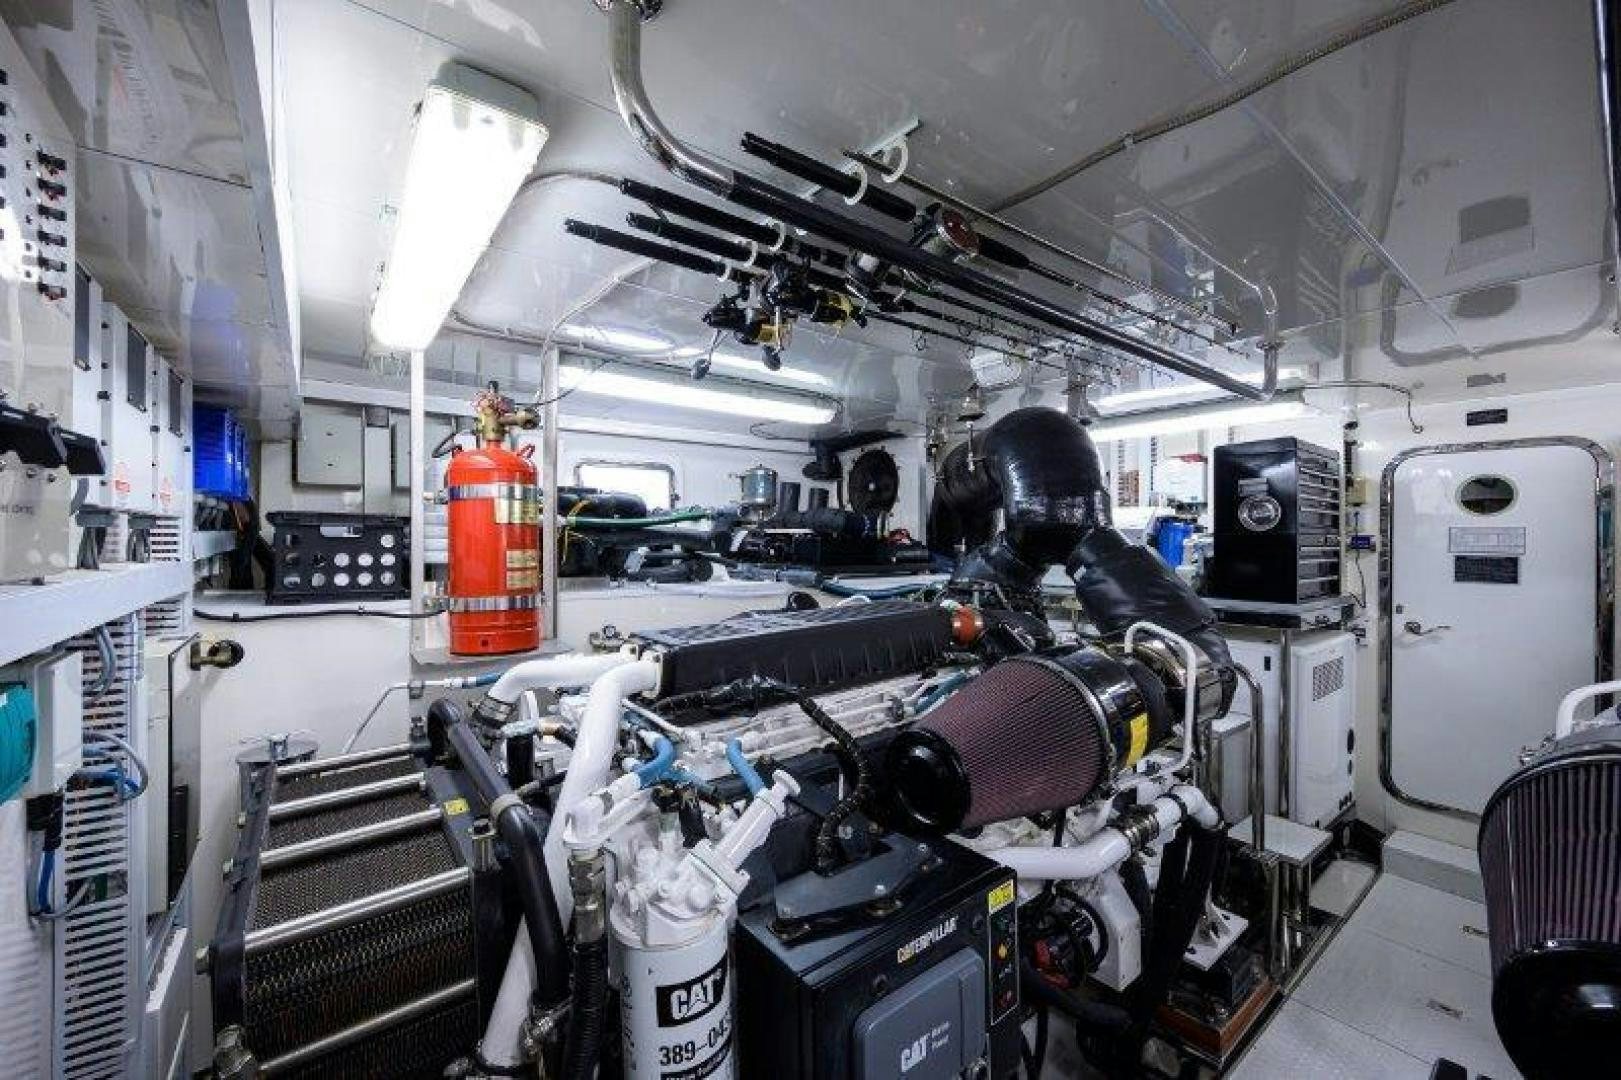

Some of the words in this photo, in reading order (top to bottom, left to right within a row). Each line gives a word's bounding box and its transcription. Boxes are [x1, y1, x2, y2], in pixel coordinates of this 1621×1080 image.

[897, 916, 958, 964] CATERPILLAR
[670, 967, 722, 1020] CAT
[901, 1033, 930, 1073] CAT
